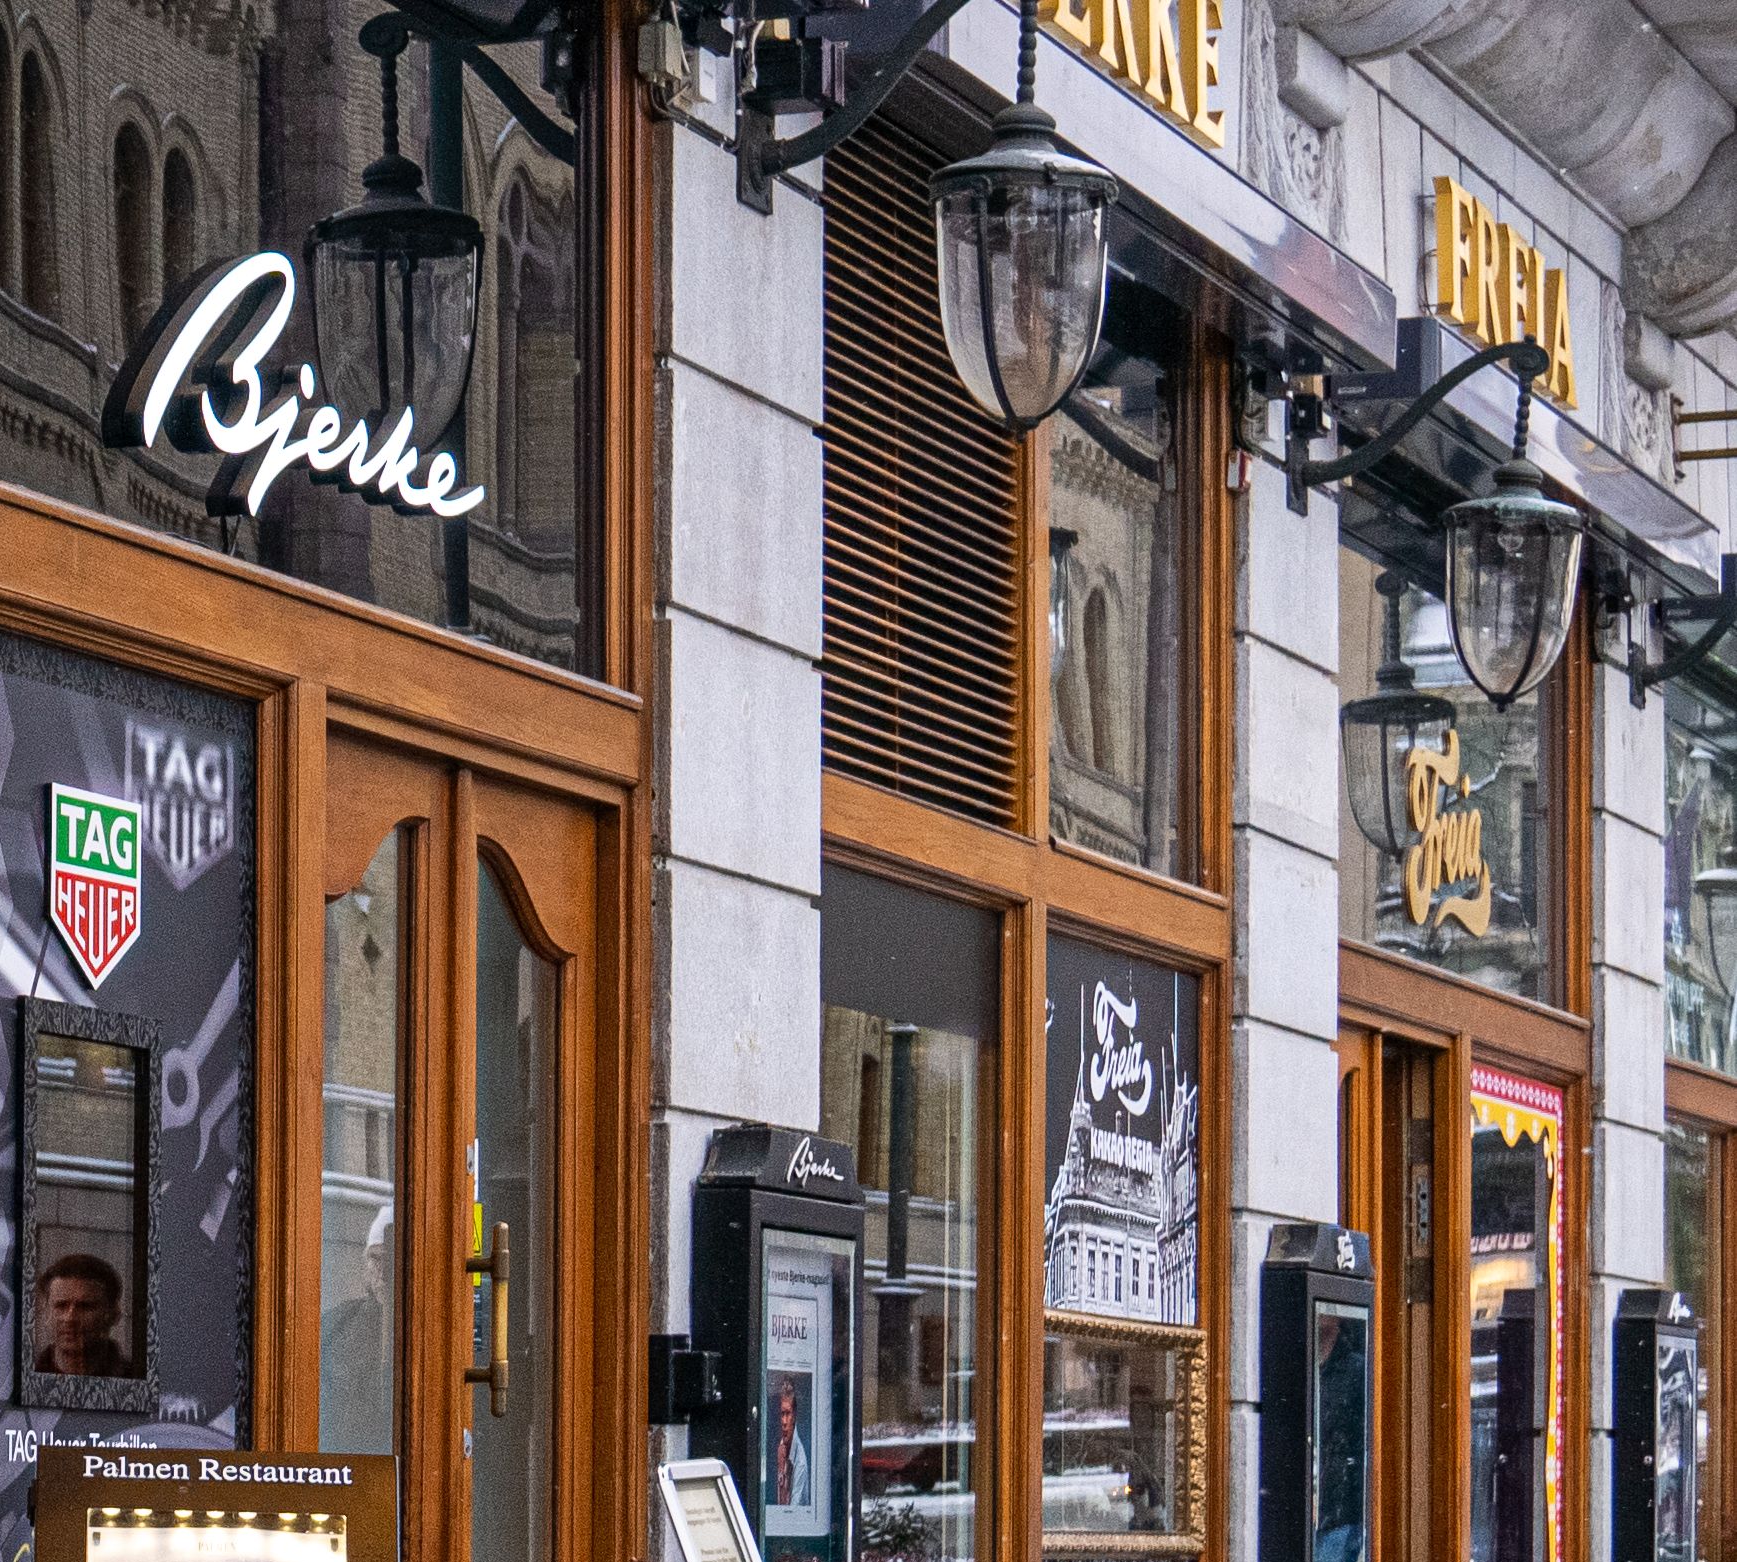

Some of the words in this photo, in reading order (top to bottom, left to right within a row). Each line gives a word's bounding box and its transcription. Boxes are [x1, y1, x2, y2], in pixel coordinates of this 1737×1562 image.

[1433, 176, 1578, 409] FREIA
[143, 252, 485, 517] Bjerke
[136, 725, 223, 802] TAG
[60, 803, 133, 870] TAG
[1407, 728, 1491, 938] Freia
[57, 875, 134, 966] HEUER
[1090, 980, 1152, 1116] Freia
[787, 1137, 844, 1188] Bjerke
[1090, 1126, 1124, 1168] KAKAO
[1125, 1135, 1153, 1175] REGIA
[771, 1314, 808, 1343] BJERKE
[5, 1429, 37, 1462] TAG
[83, 1455, 190, 1481] Palmen
[199, 1459, 352, 1486] Restaurant
